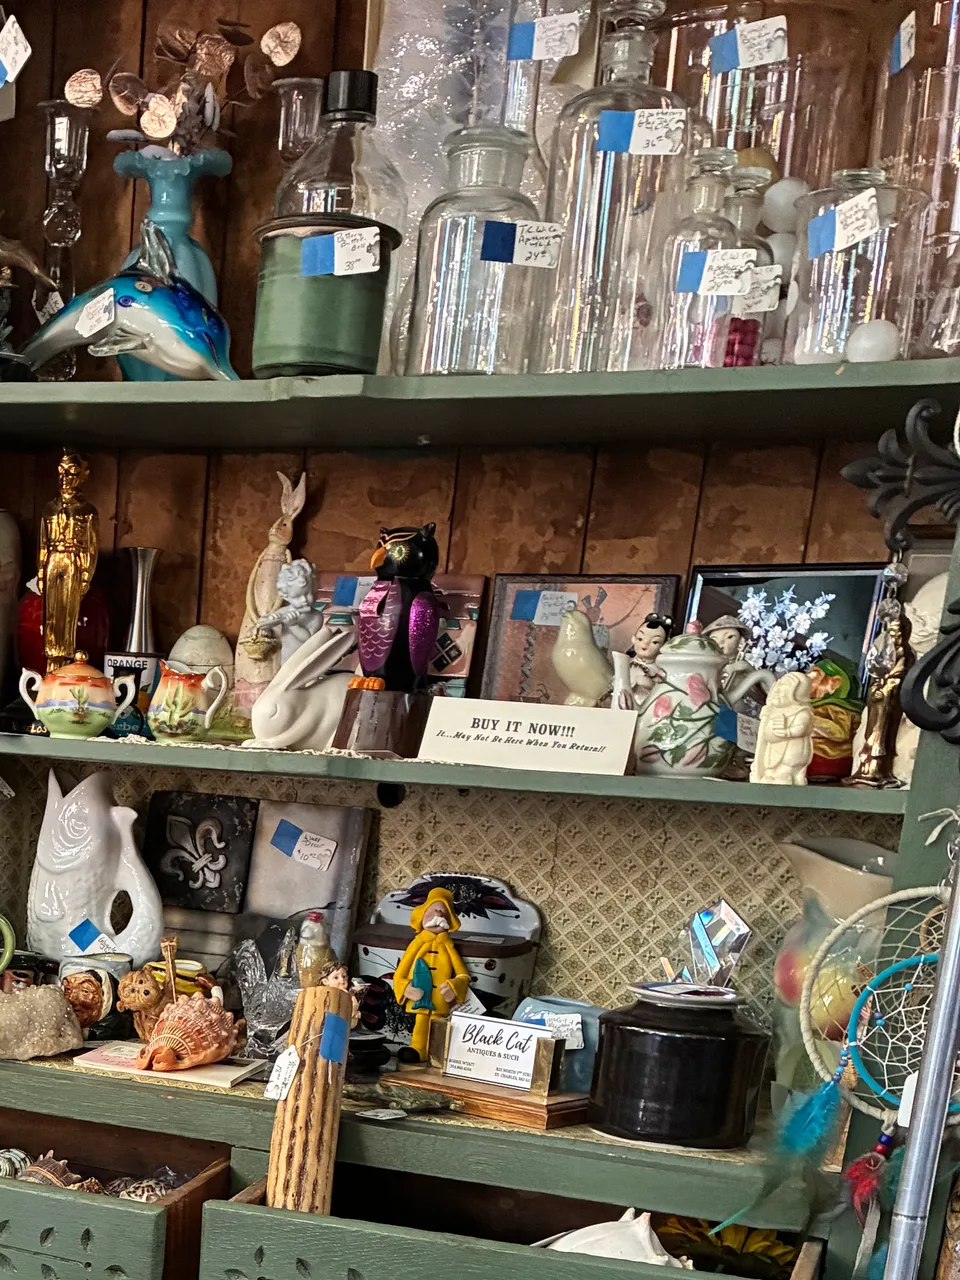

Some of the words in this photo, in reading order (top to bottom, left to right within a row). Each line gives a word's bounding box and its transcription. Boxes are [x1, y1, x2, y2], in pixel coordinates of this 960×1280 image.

[107, 658, 148, 669] ORANGE
[470, 716, 501, 731] BUY
[505, 720, 523, 733] IT
[527, 722, 576, 738] NOW!!!
[473, 733, 489, 743] Not
[491, 735, 503, 744] Be
[504, 736, 524, 746] Here
[525, 738, 549, 748] When
[551, 740, 568, 750] You
[568, 742, 607, 754] Return!!
[461, 1023, 504, 1046] Black
[505, 1031, 534, 1053] Cat
[467, 1047, 496, 1057] ANTIQUES
[503, 1053, 520, 1062] SUCH
